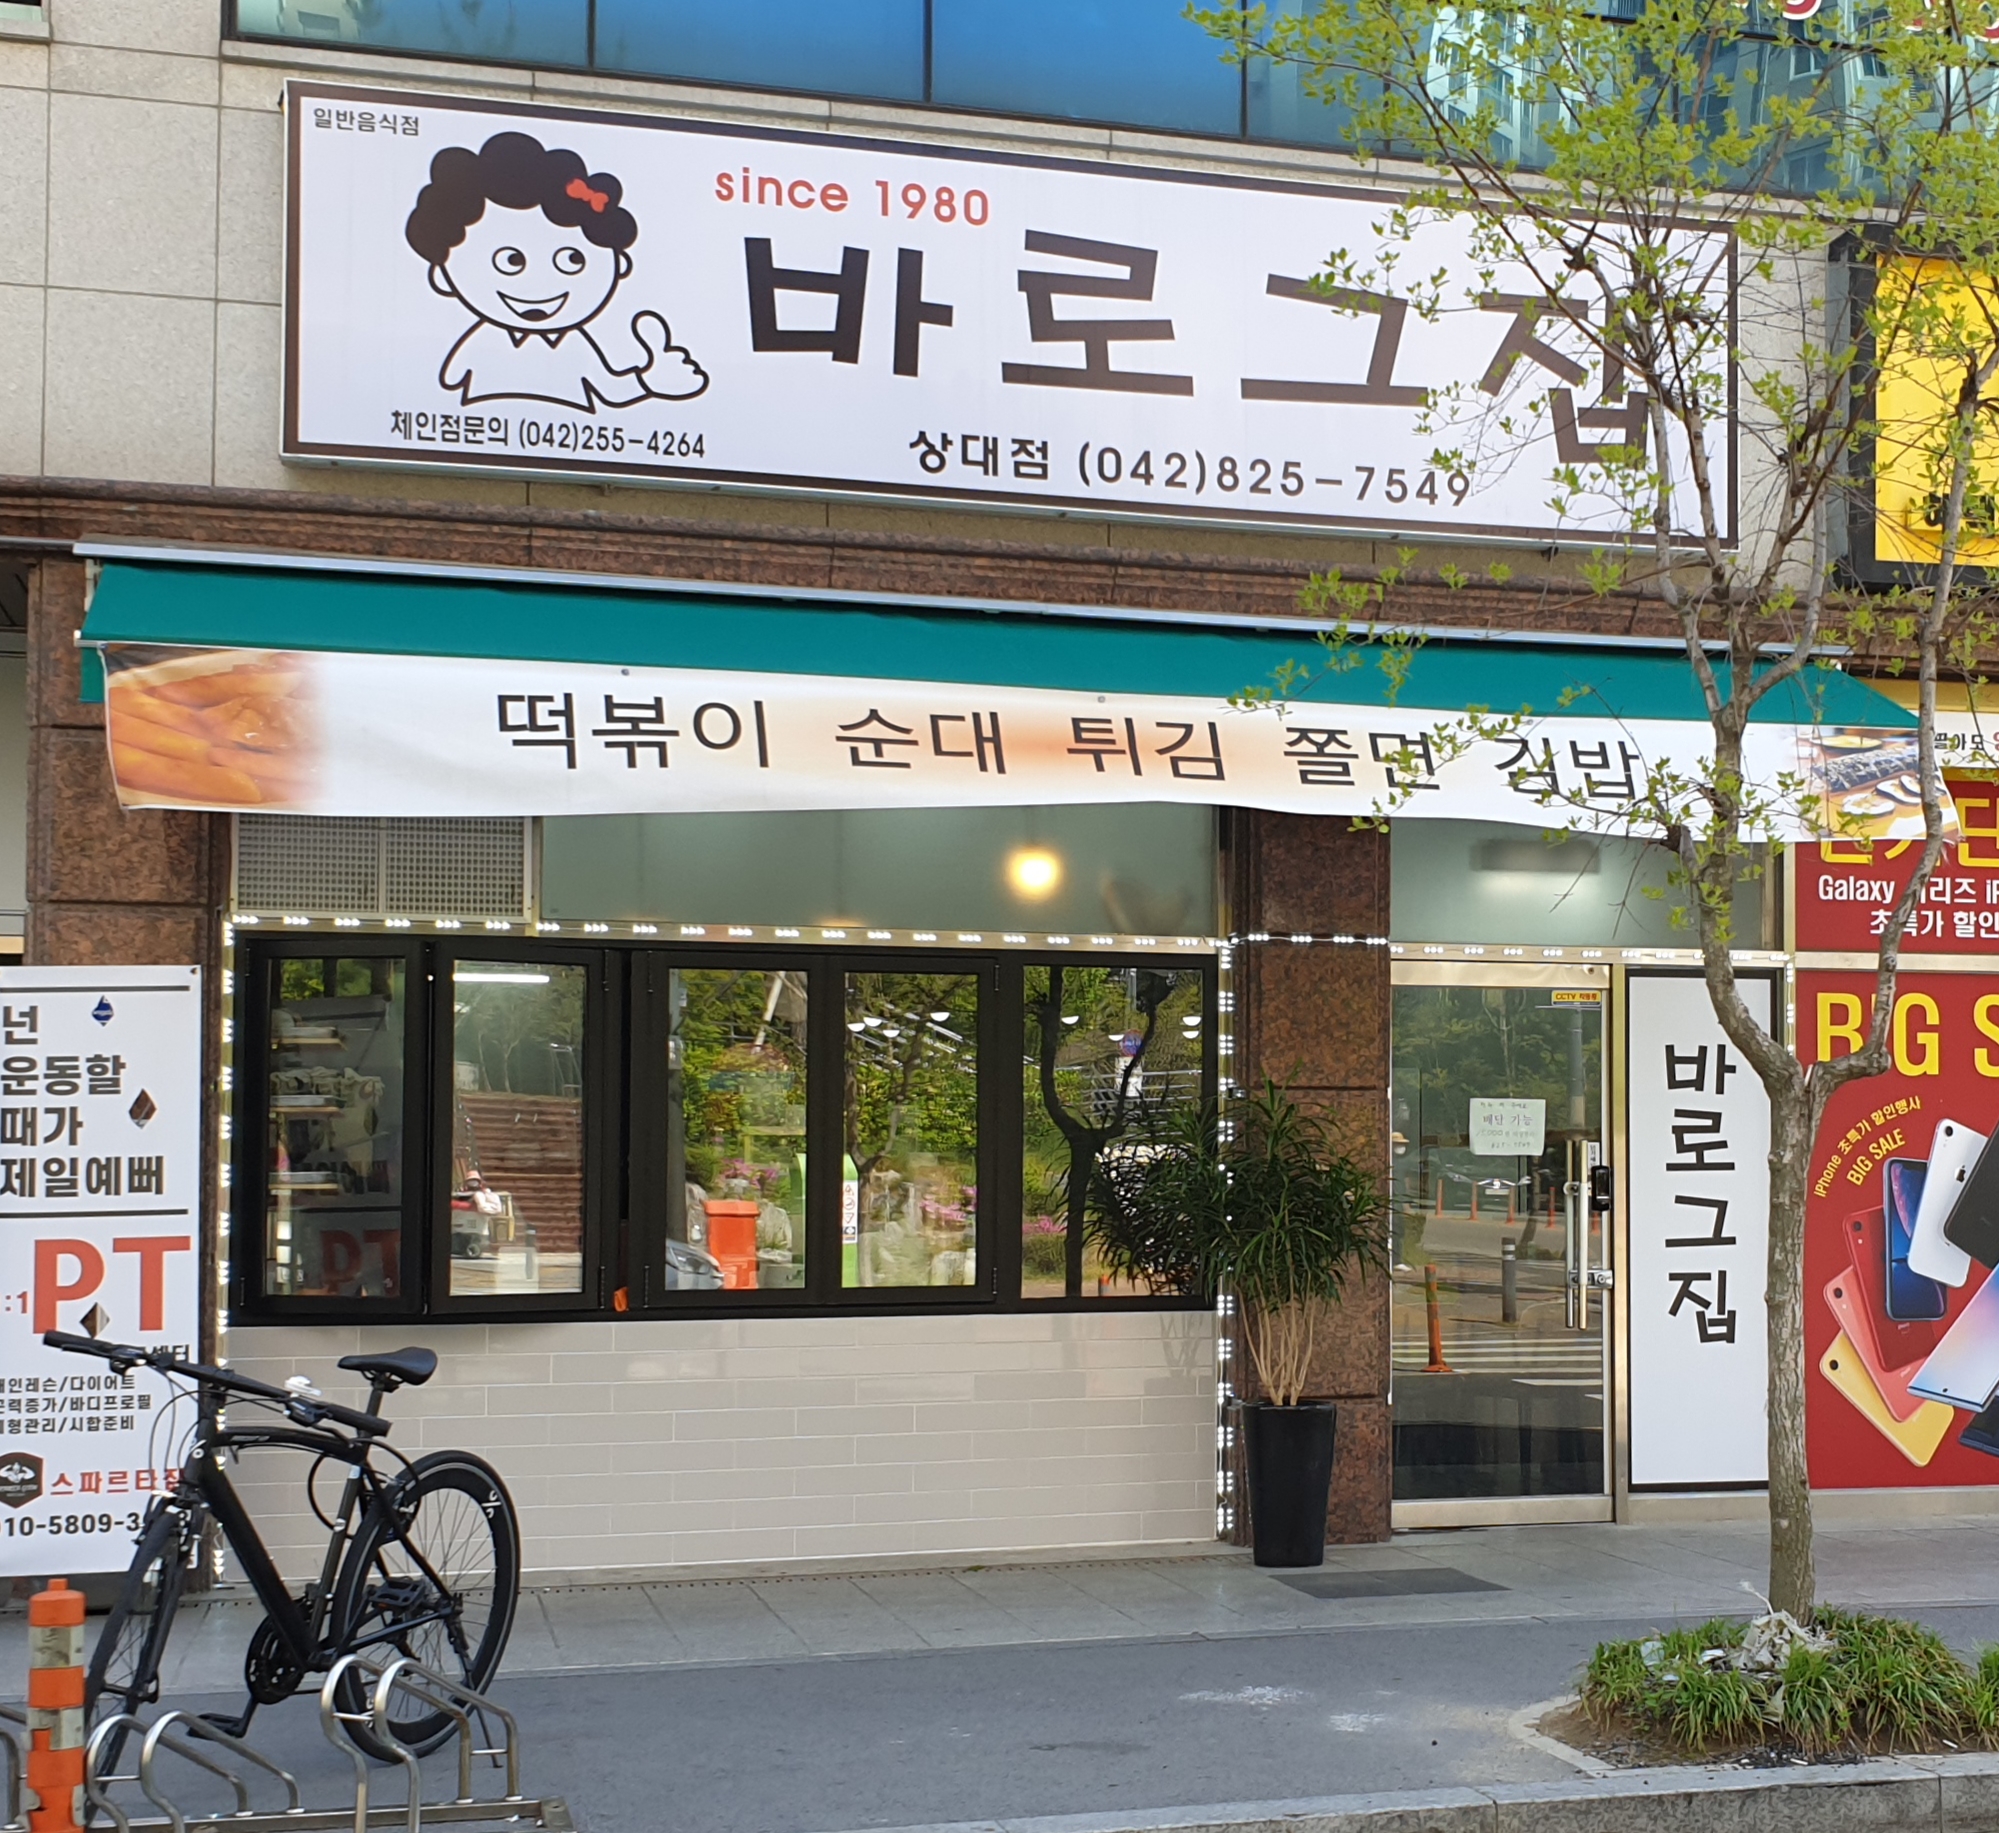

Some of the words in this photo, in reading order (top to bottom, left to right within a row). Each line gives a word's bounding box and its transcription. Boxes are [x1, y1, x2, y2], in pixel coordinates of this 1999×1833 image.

[313, 107, 419, 136] 일반음식점
[715, 166, 849, 212] since
[875, 179, 990, 226] 1980
[744, 229, 1650, 470] 바로그집
[391, 409, 509, 446] 체인점문의
[519, 417, 706, 458] (042)255-4264
[909, 430, 1050, 481] 상대점
[1078, 441, 1470, 507] (042)825-7549
[497, 692, 769, 770] 떡볶이
[835, 706, 1008, 775] 순대
[1066, 715, 1228, 783] 튀김
[1283, 726, 1440, 790] 쫄면
[1494, 736, 1640, 800] 김밥
[1818, 874, 1895, 904] Galaxy
[1920, 877, 1977, 905] 리즈
[3, 1006, 38, 1045] 넌
[1817, 992, 1940, 1077] BG
[1, 1054, 127, 1096] 운동할
[0, 1106, 84, 1146] 때가
[0, 1155, 164, 1198] 제일예뻐
[1846, 1155, 1873, 1186] BIG
[1868, 1128, 1906, 1160] SALE
[1665, 1043, 1737, 1344] 바로그집
[32, 1235, 192, 1334] PT
[0, 1375, 135, 1394] 인레슨/다이어트
[0, 1394, 152, 1414] 력증가/바디프로필
[0, 1415, 135, 1435] 형관리/시합준비
[0, 1512, 141, 1537] 10-5809-3
